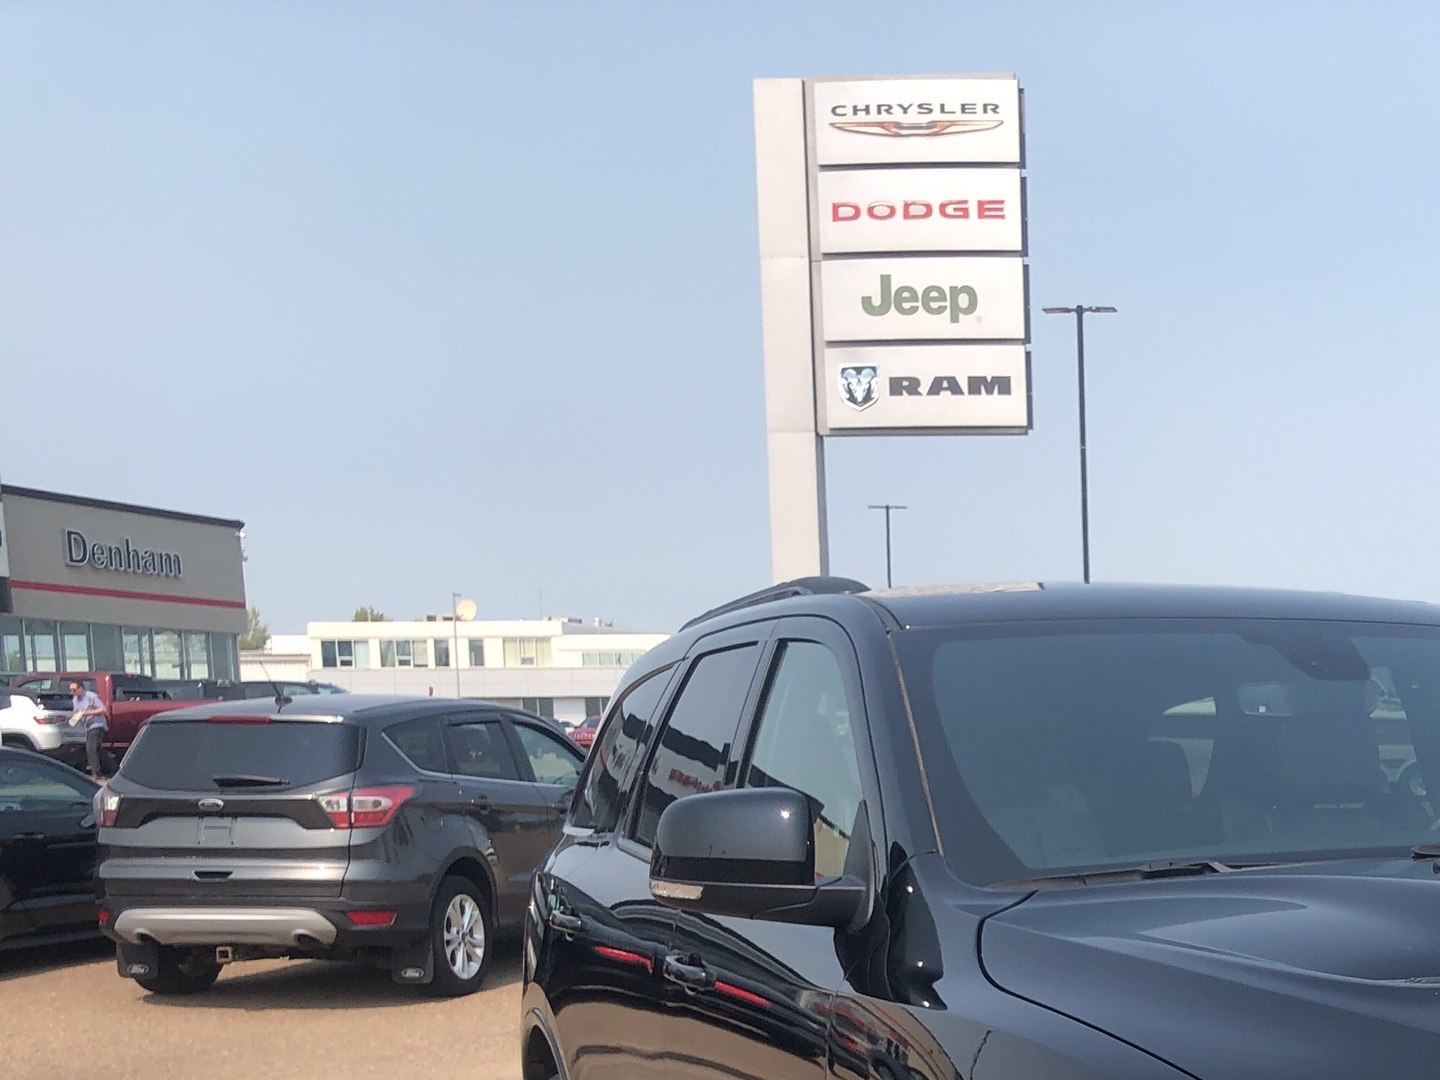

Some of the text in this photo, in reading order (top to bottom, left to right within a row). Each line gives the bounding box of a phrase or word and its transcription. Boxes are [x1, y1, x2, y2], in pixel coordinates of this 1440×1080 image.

[830, 102, 1001, 117] CHRYSLER
[831, 199, 1006, 222] DODGE
[861, 274, 979, 323] Jeep
[888, 375, 1012, 397] RAM
[65, 528, 183, 577] Denham
